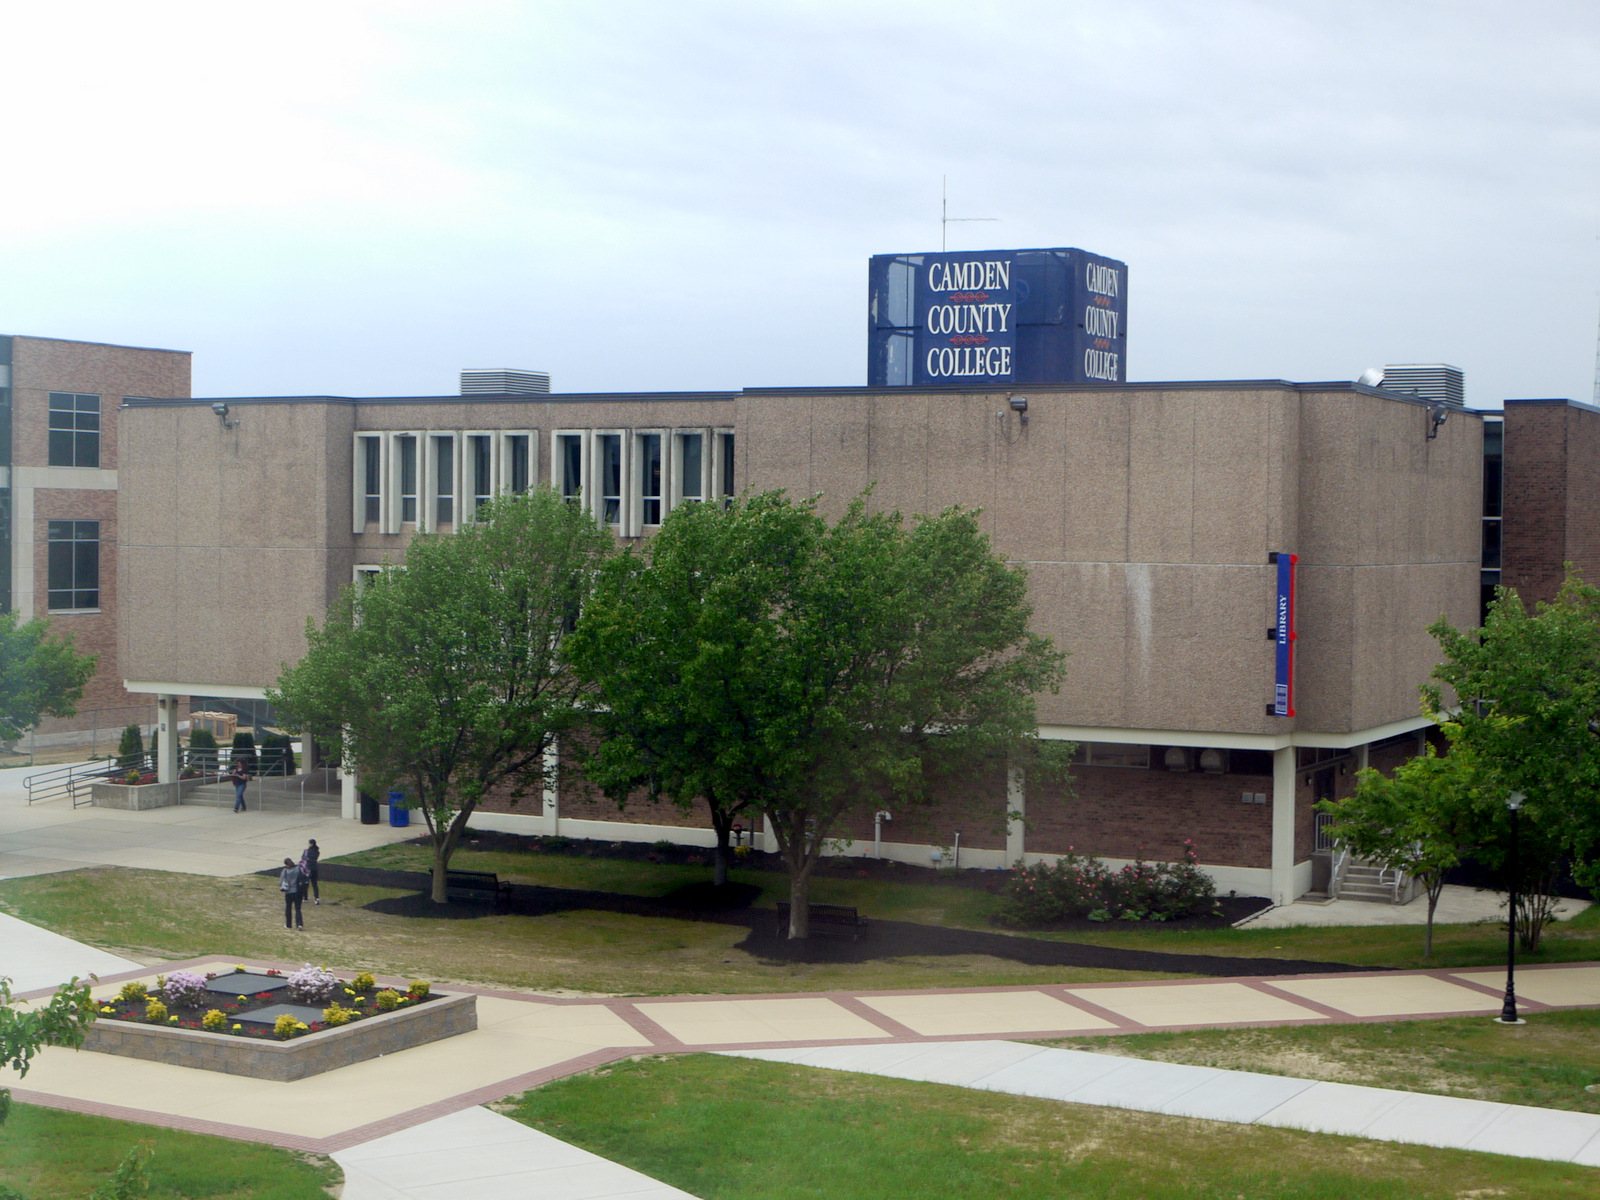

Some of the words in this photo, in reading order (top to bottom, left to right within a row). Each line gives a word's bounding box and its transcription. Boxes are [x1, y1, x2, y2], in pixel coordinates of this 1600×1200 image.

[928, 261, 1011, 292] CAMDEN
[1086, 262, 1119, 297] CAMDEN
[927, 303, 1012, 334] COUNTY
[1085, 305, 1119, 339] COUNTY
[926, 346, 1012, 377] COLLEGE
[1084, 348, 1119, 381] COLLEGE
[1279, 595, 1287, 645] LIBRARY
